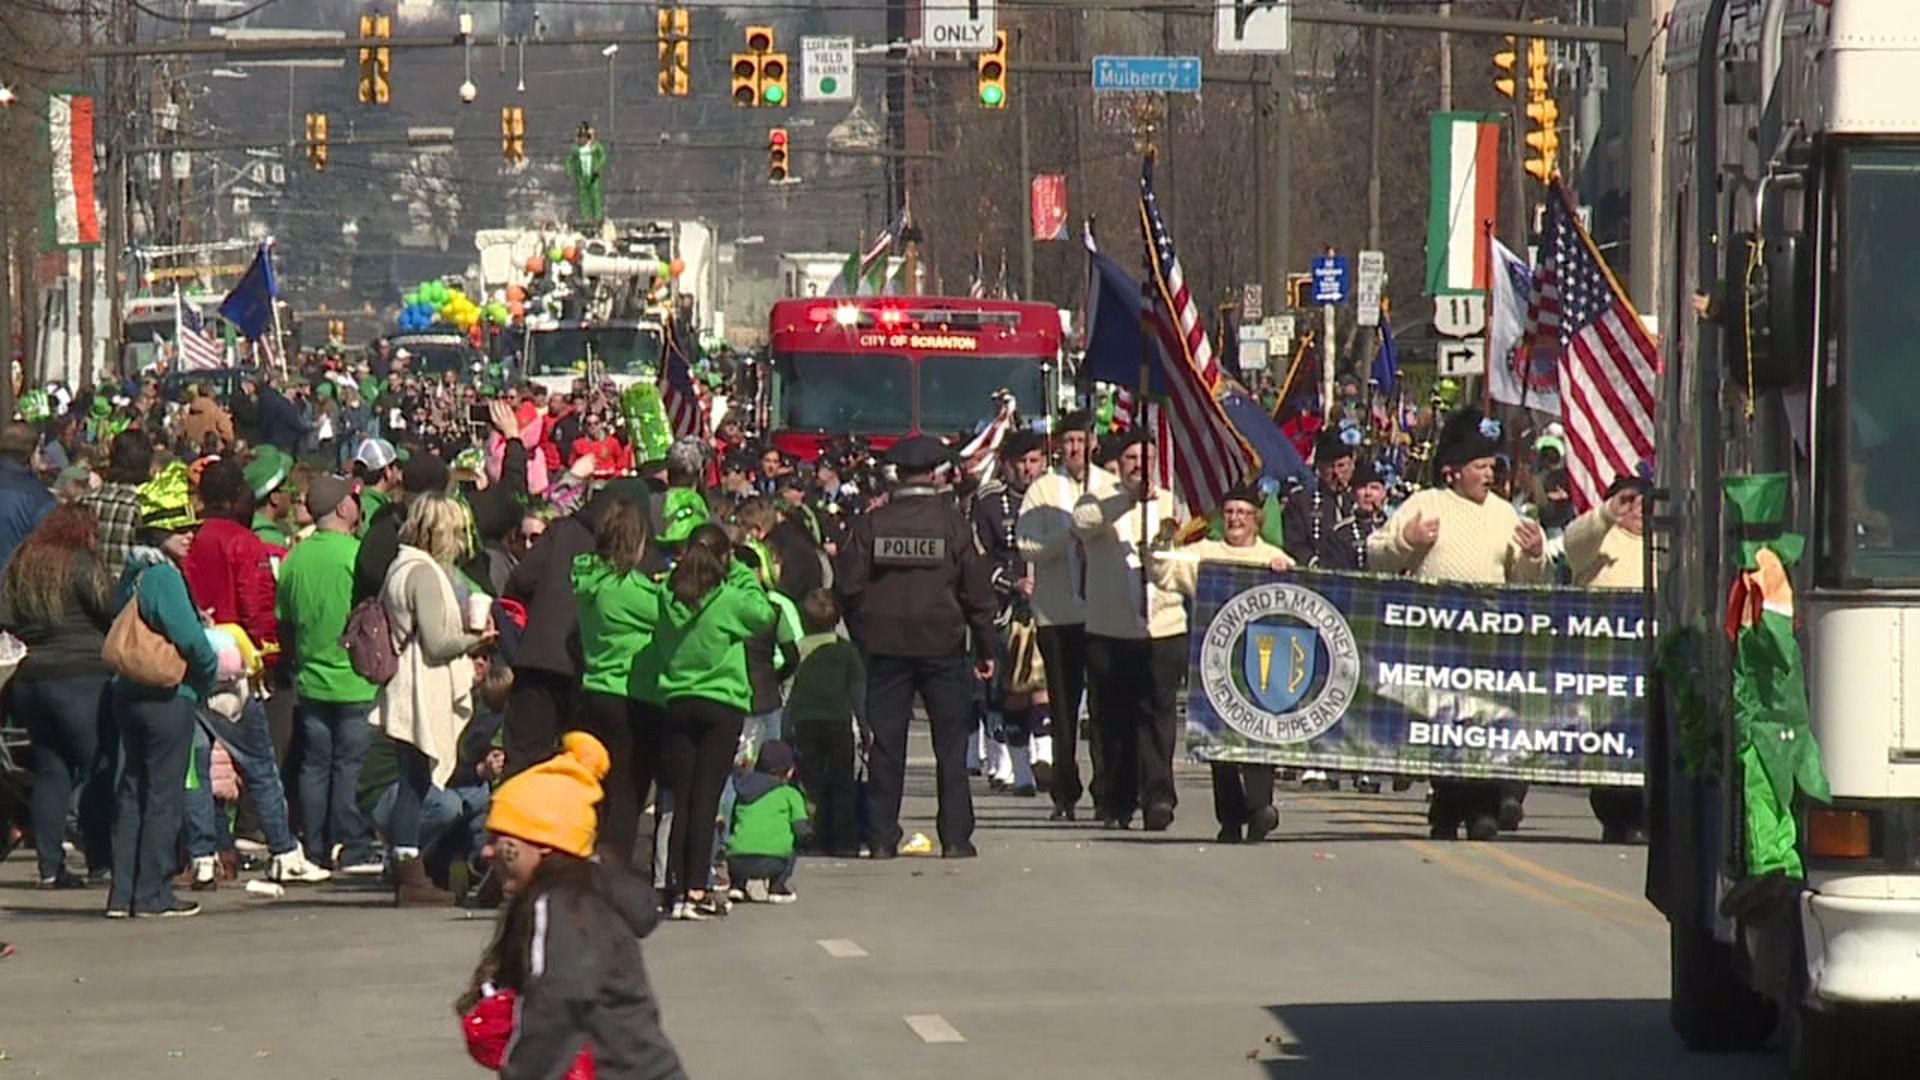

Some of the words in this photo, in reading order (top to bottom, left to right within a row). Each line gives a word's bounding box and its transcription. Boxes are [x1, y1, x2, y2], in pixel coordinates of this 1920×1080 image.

[933, 25, 985, 43] ONLY
[1100, 69, 1179, 91] Mulberry
[1450, 299, 1471, 325] 11
[860, 335, 887, 347] CITY
[890, 335, 908, 347] OF
[911, 335, 977, 351] SCRANTON
[884, 540, 937, 558] POLICE
[1211, 592, 1272, 649] EDWARD
[1291, 593, 1356, 661] MALONEY
[1384, 603, 1525, 634] EDWARD
[1532, 614, 1559, 636] P.
[1378, 662, 1548, 695] MEMORIAL
[1556, 672, 1629, 698] PIPE
[1211, 676, 1273, 738] MEMORIAL
[1277, 717, 1314, 739] PIPE
[1311, 687, 1346, 726] BAND
[1408, 722, 1636, 760] BINGHAMTON,
